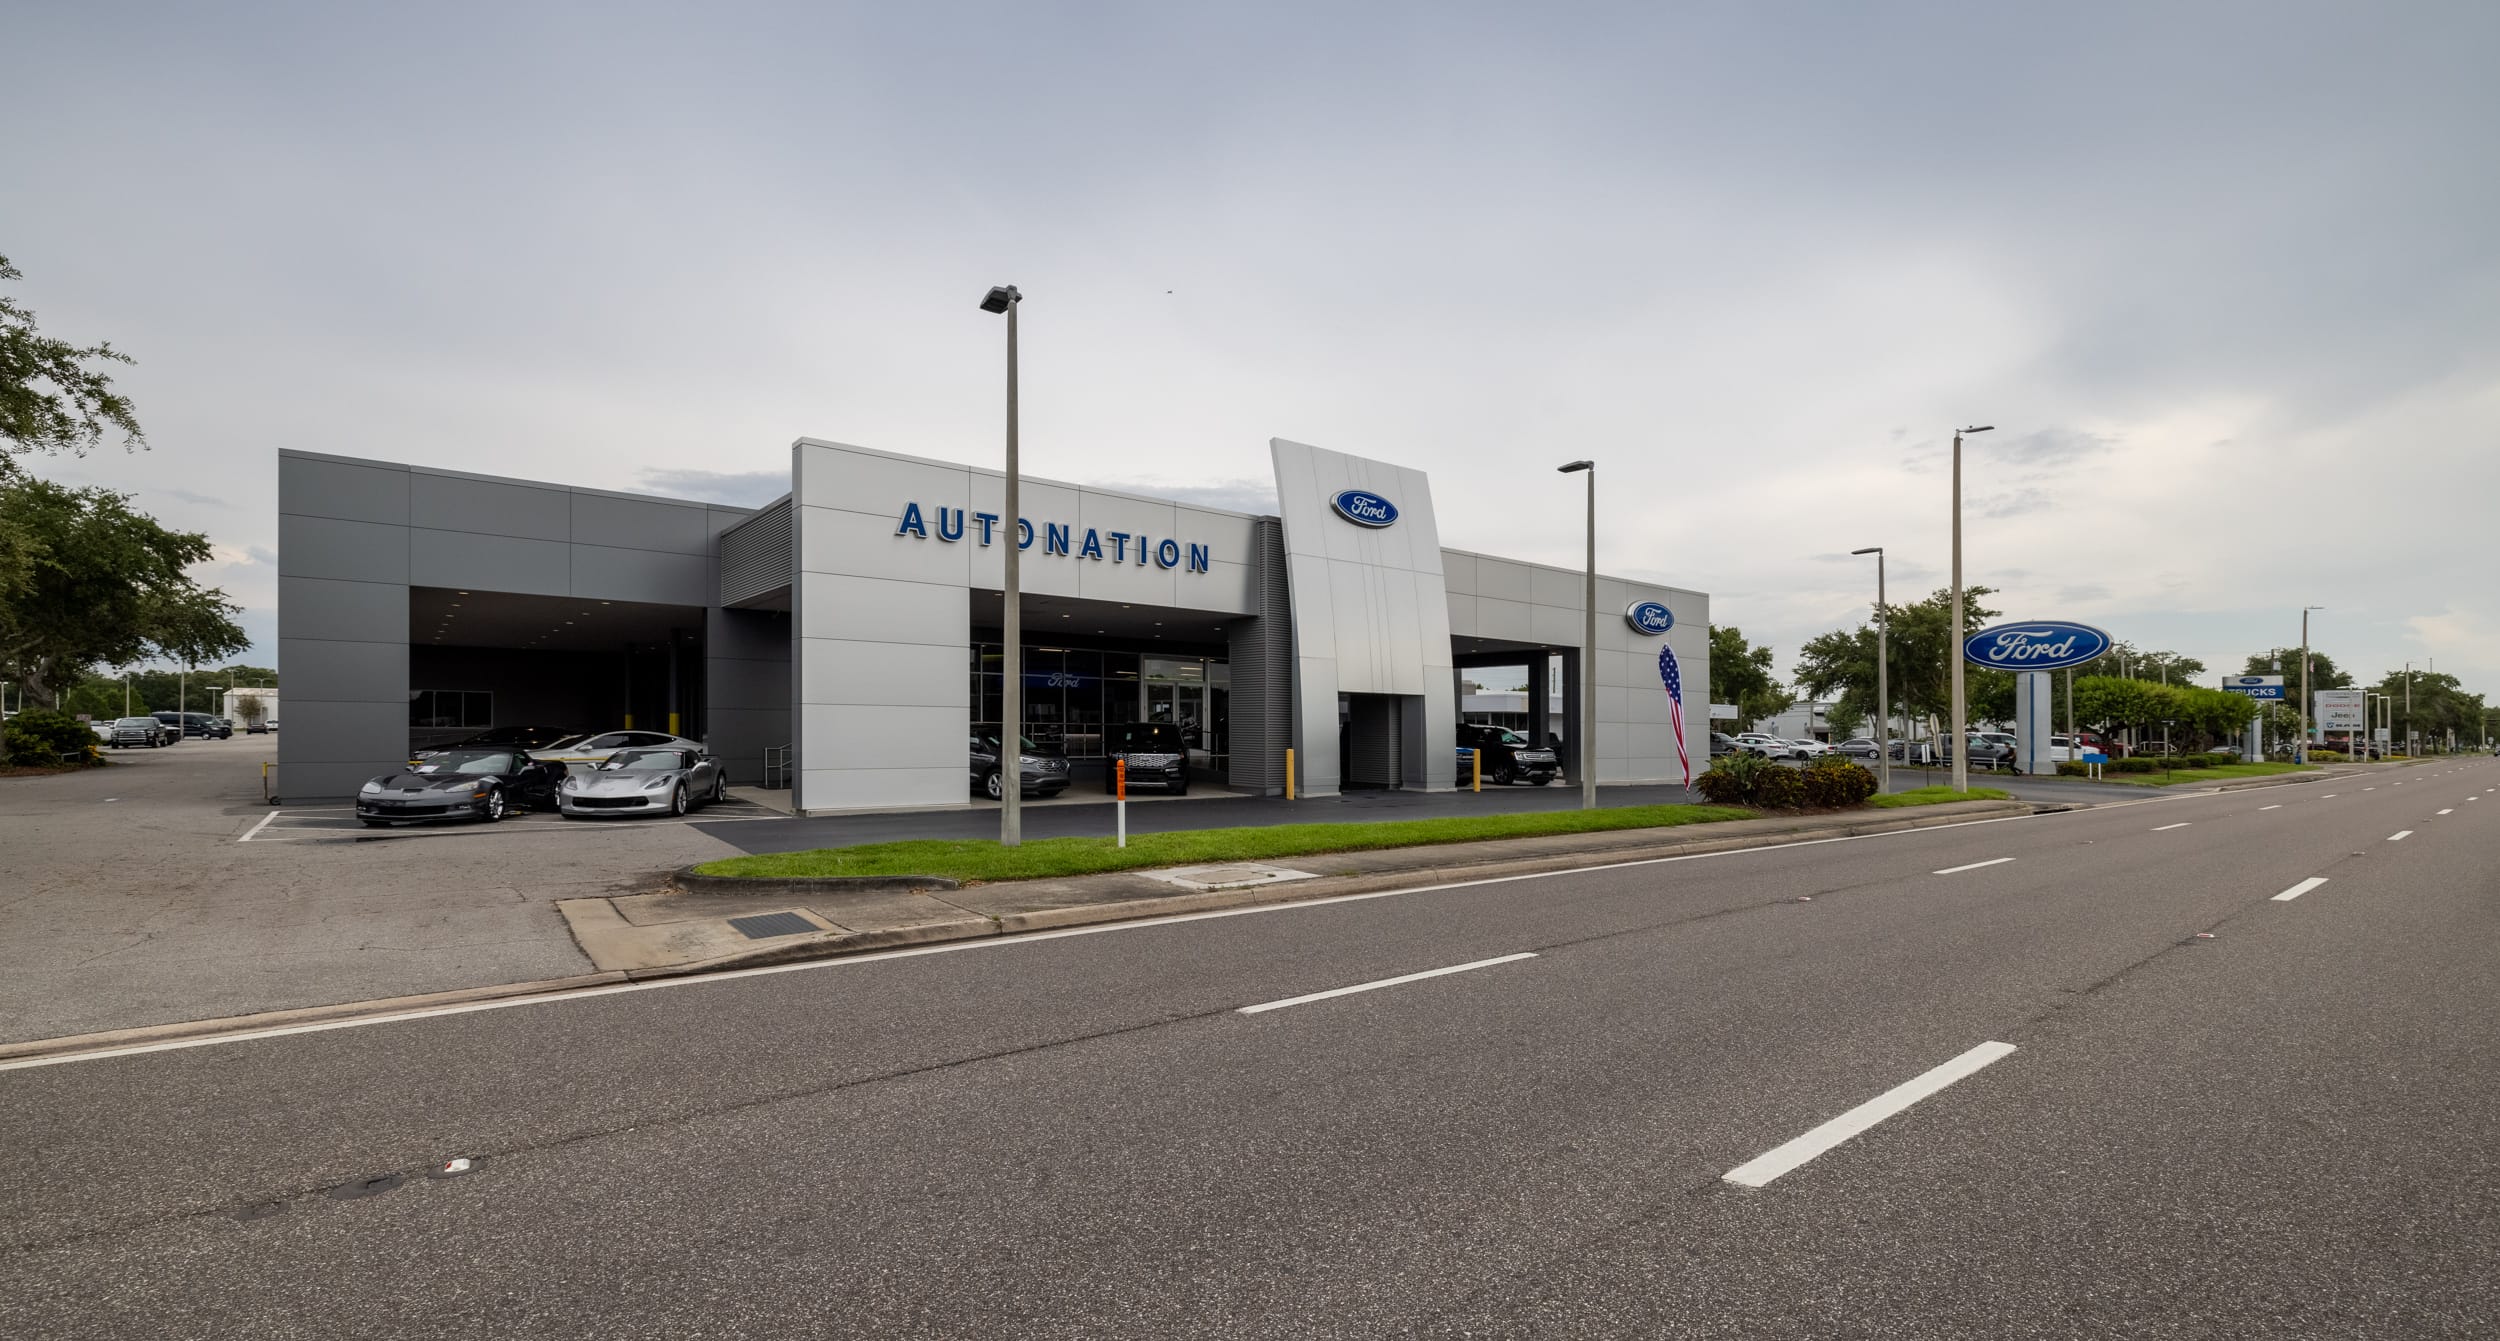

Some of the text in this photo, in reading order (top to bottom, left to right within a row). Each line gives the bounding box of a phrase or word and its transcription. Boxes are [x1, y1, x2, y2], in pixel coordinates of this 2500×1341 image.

[1351, 495, 1387, 519] Ford
[897, 501, 1209, 573] AUTONATION
[1642, 607, 1668, 627] Ford
[1988, 630, 2077, 661] Ford
[1047, 672, 1080, 688] Ford
